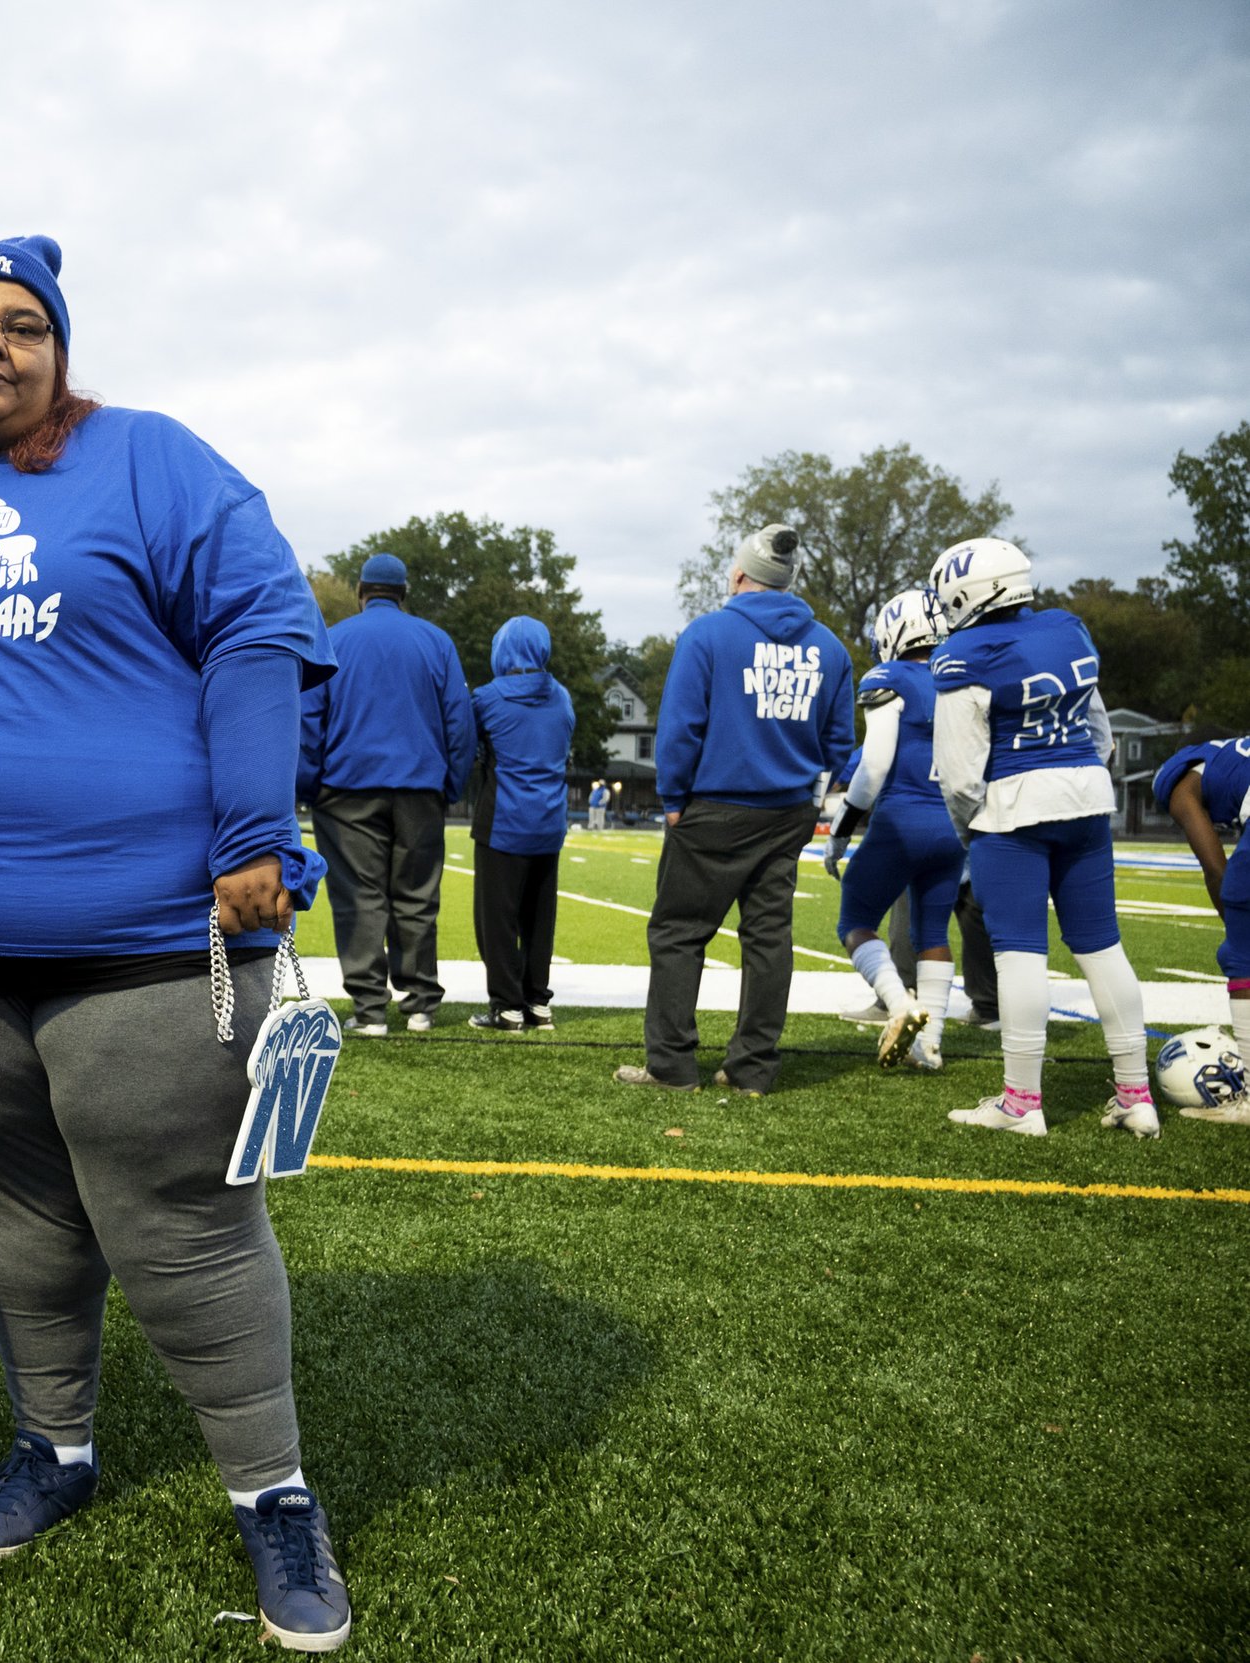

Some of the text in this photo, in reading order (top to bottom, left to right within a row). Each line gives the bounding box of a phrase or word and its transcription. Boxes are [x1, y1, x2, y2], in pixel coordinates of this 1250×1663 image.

[944, 551, 975, 584] N
[753, 642, 820, 671] MPLS
[743, 668, 824, 697] NORTH
[278, 1494, 310, 1506] adidas
